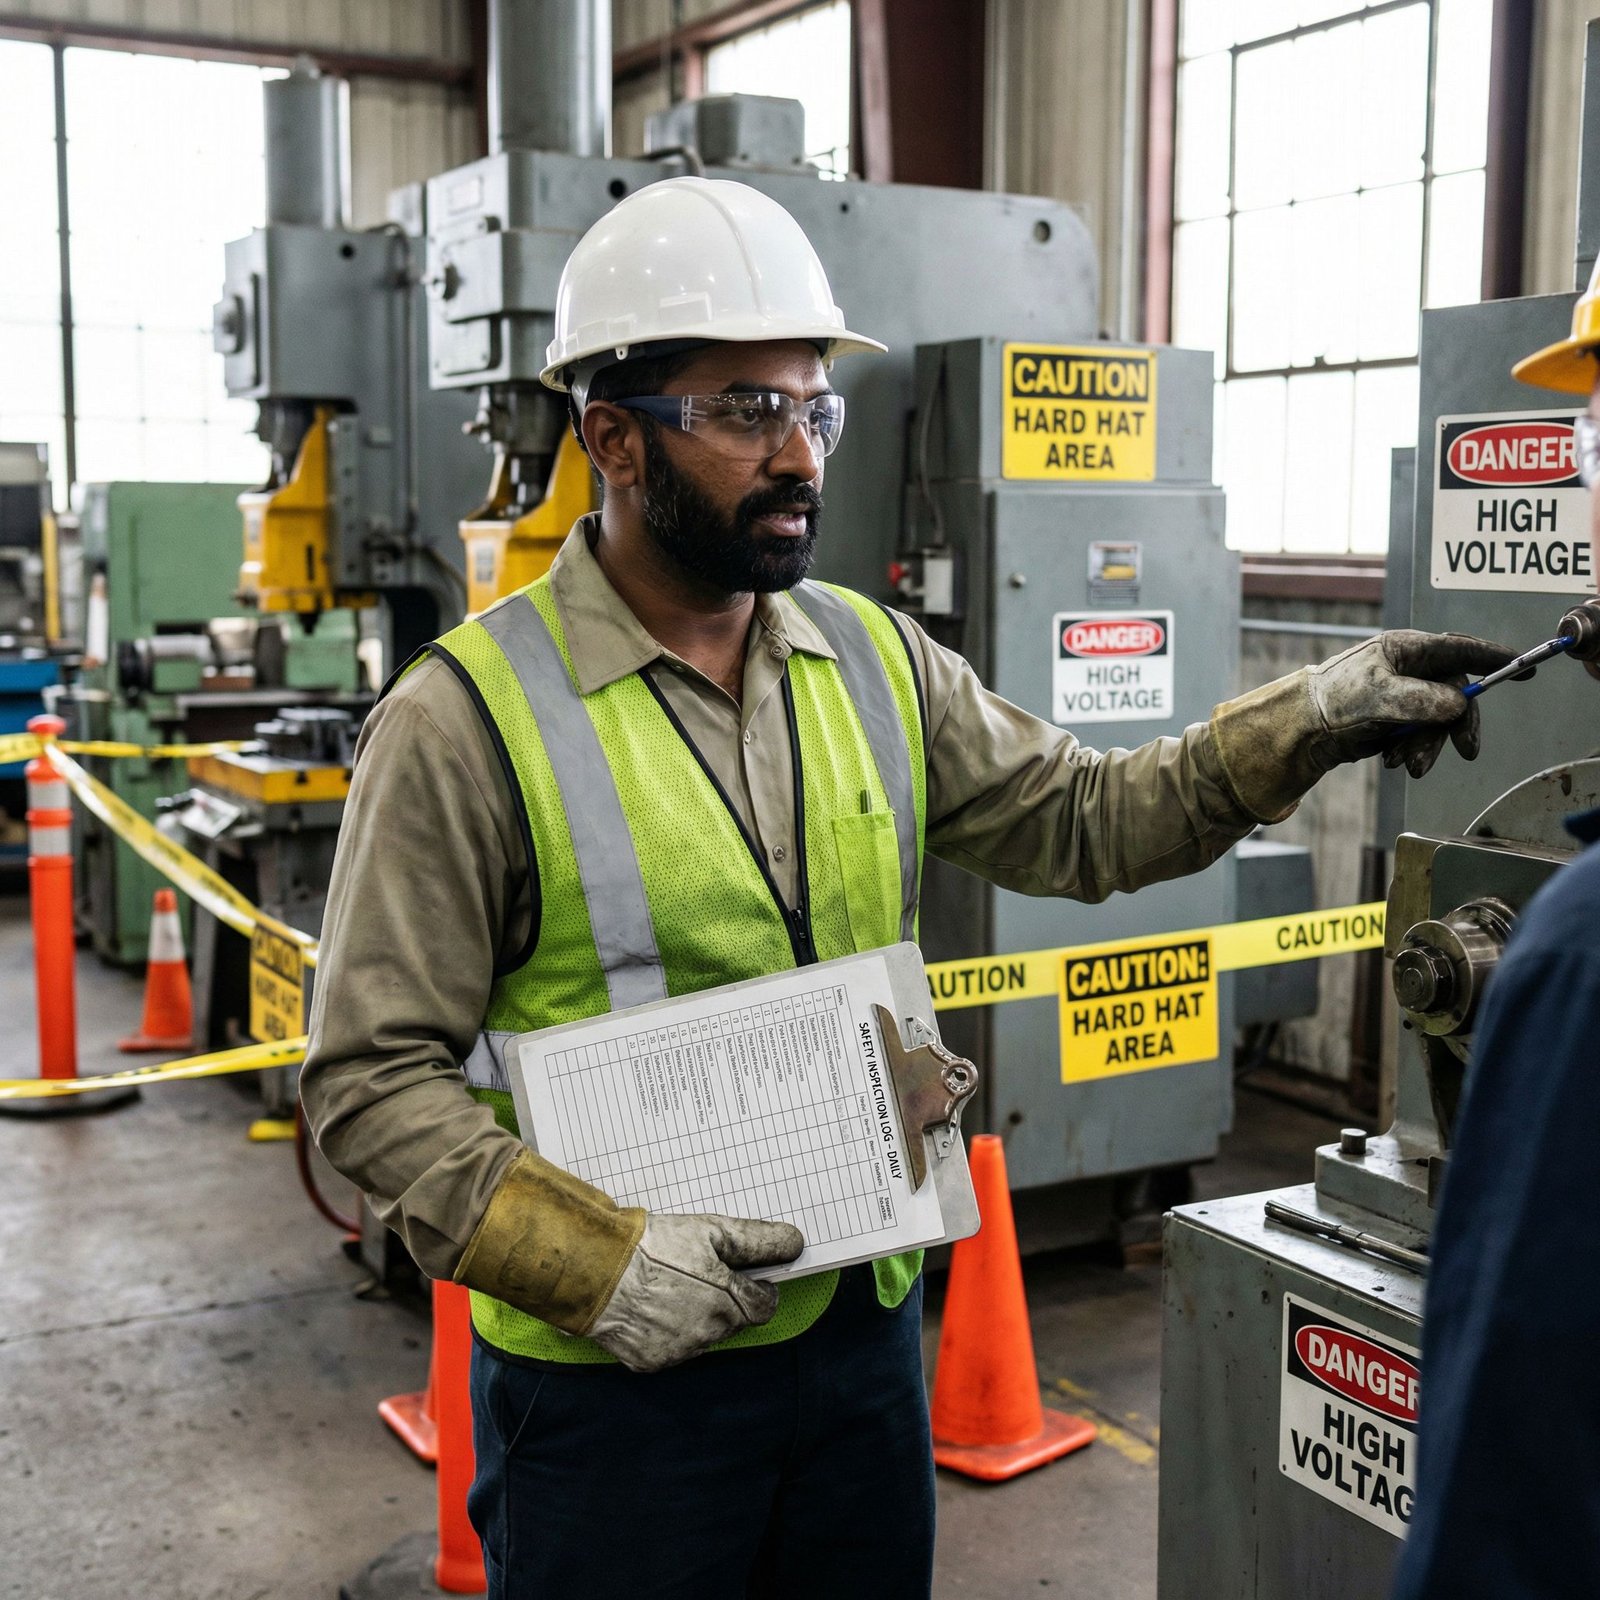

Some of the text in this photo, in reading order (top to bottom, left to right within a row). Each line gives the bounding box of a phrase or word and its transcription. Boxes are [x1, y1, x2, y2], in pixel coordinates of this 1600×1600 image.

[1014, 358, 1147, 397] CAUTION
[1014, 407, 1146, 436] HARD HAT
[1045, 443, 1115, 470] AREA
[1459, 436, 1578, 471] DANGER
[1477, 498, 1557, 532] HIGH
[1445, 541, 1591, 576] VOLTAGE
[1070, 626, 1156, 651] DANGER
[1087, 665, 1141, 685] HIGH
[1063, 689, 1163, 711] VOLTAGE
[1277, 912, 1384, 950] CAUTION
[927, 963, 1025, 999] AUTION
[1069, 946, 1207, 996] CAUTION:
[1073, 992, 1204, 1036] HARD HAT
[859, 1022, 876, 1059] SAFETY
[1105, 1030, 1174, 1065] AREA
[880, 1120, 894, 1142] LOG
[886, 1150, 903, 1179] DAILY
[1323, 1402, 1405, 1476] HIGH
[1290, 1428, 1416, 1524] VOLTAG
